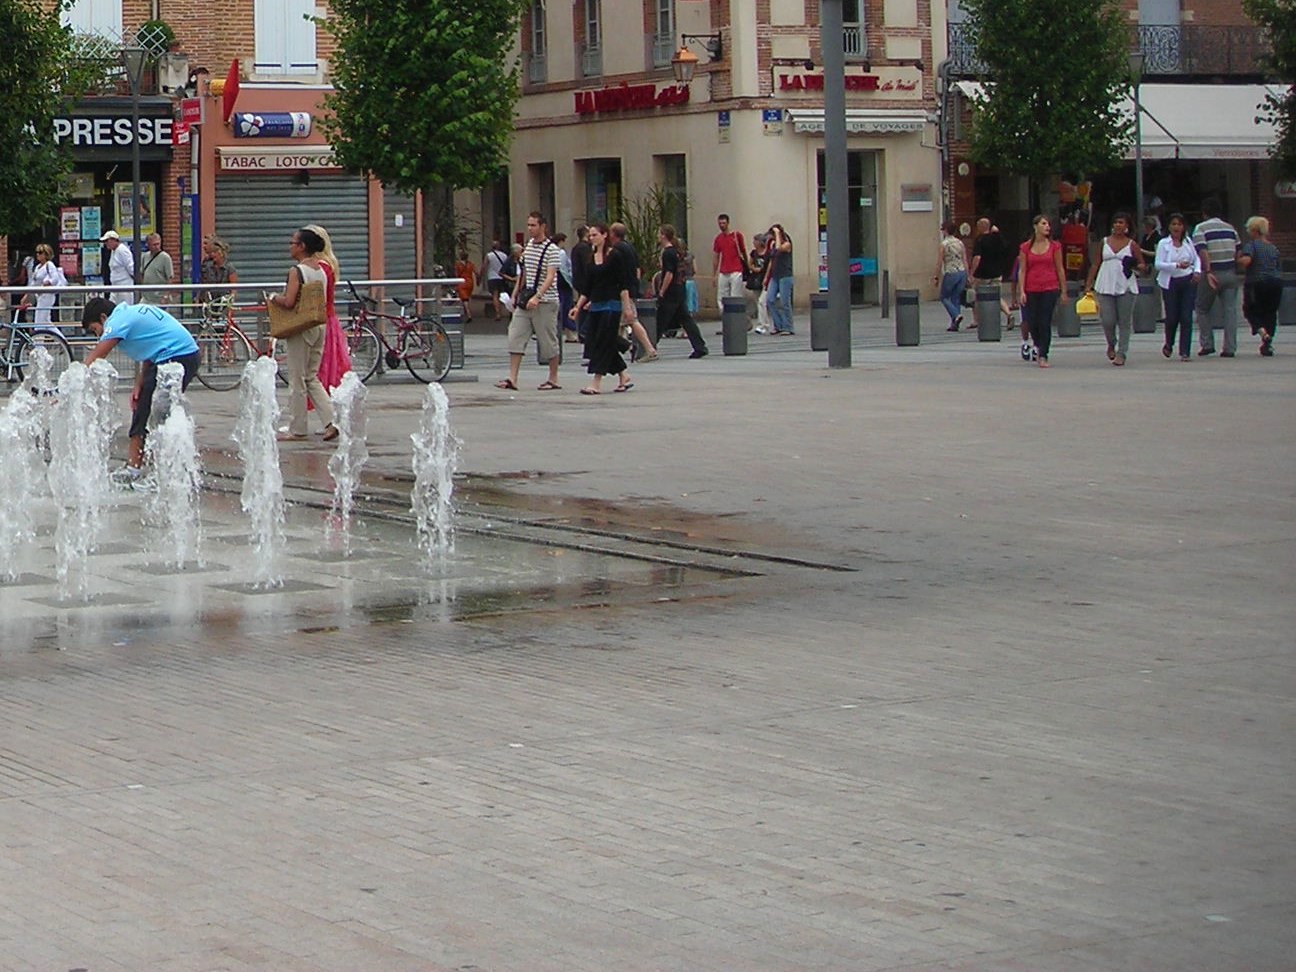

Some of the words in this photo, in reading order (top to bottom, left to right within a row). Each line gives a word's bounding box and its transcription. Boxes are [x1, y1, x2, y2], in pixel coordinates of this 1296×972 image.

[54, 118, 174, 145] PRESSE
[223, 156, 266, 167] TABAC
[276, 156, 309, 168] LOTO
